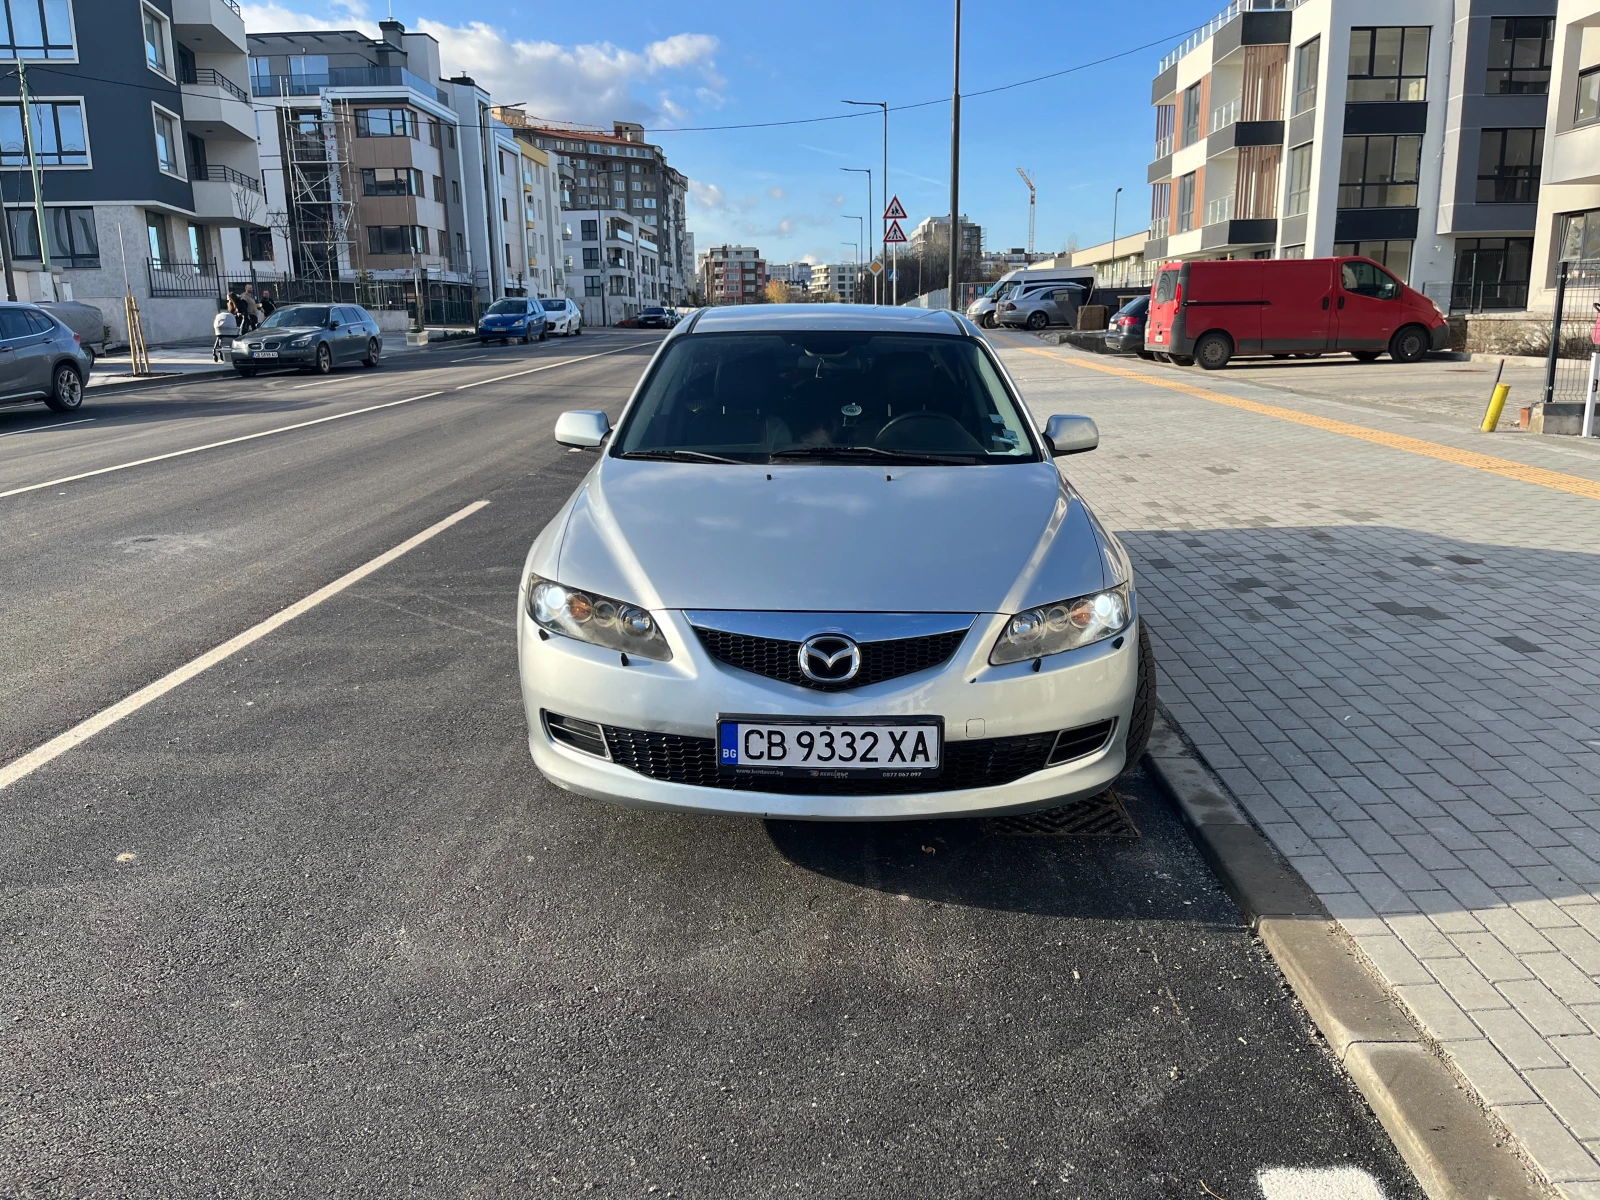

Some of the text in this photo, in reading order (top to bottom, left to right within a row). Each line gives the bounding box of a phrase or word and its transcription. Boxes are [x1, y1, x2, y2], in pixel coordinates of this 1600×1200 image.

[722, 748, 737, 758] BG
[744, 729, 930, 763] CB 9332 XA
